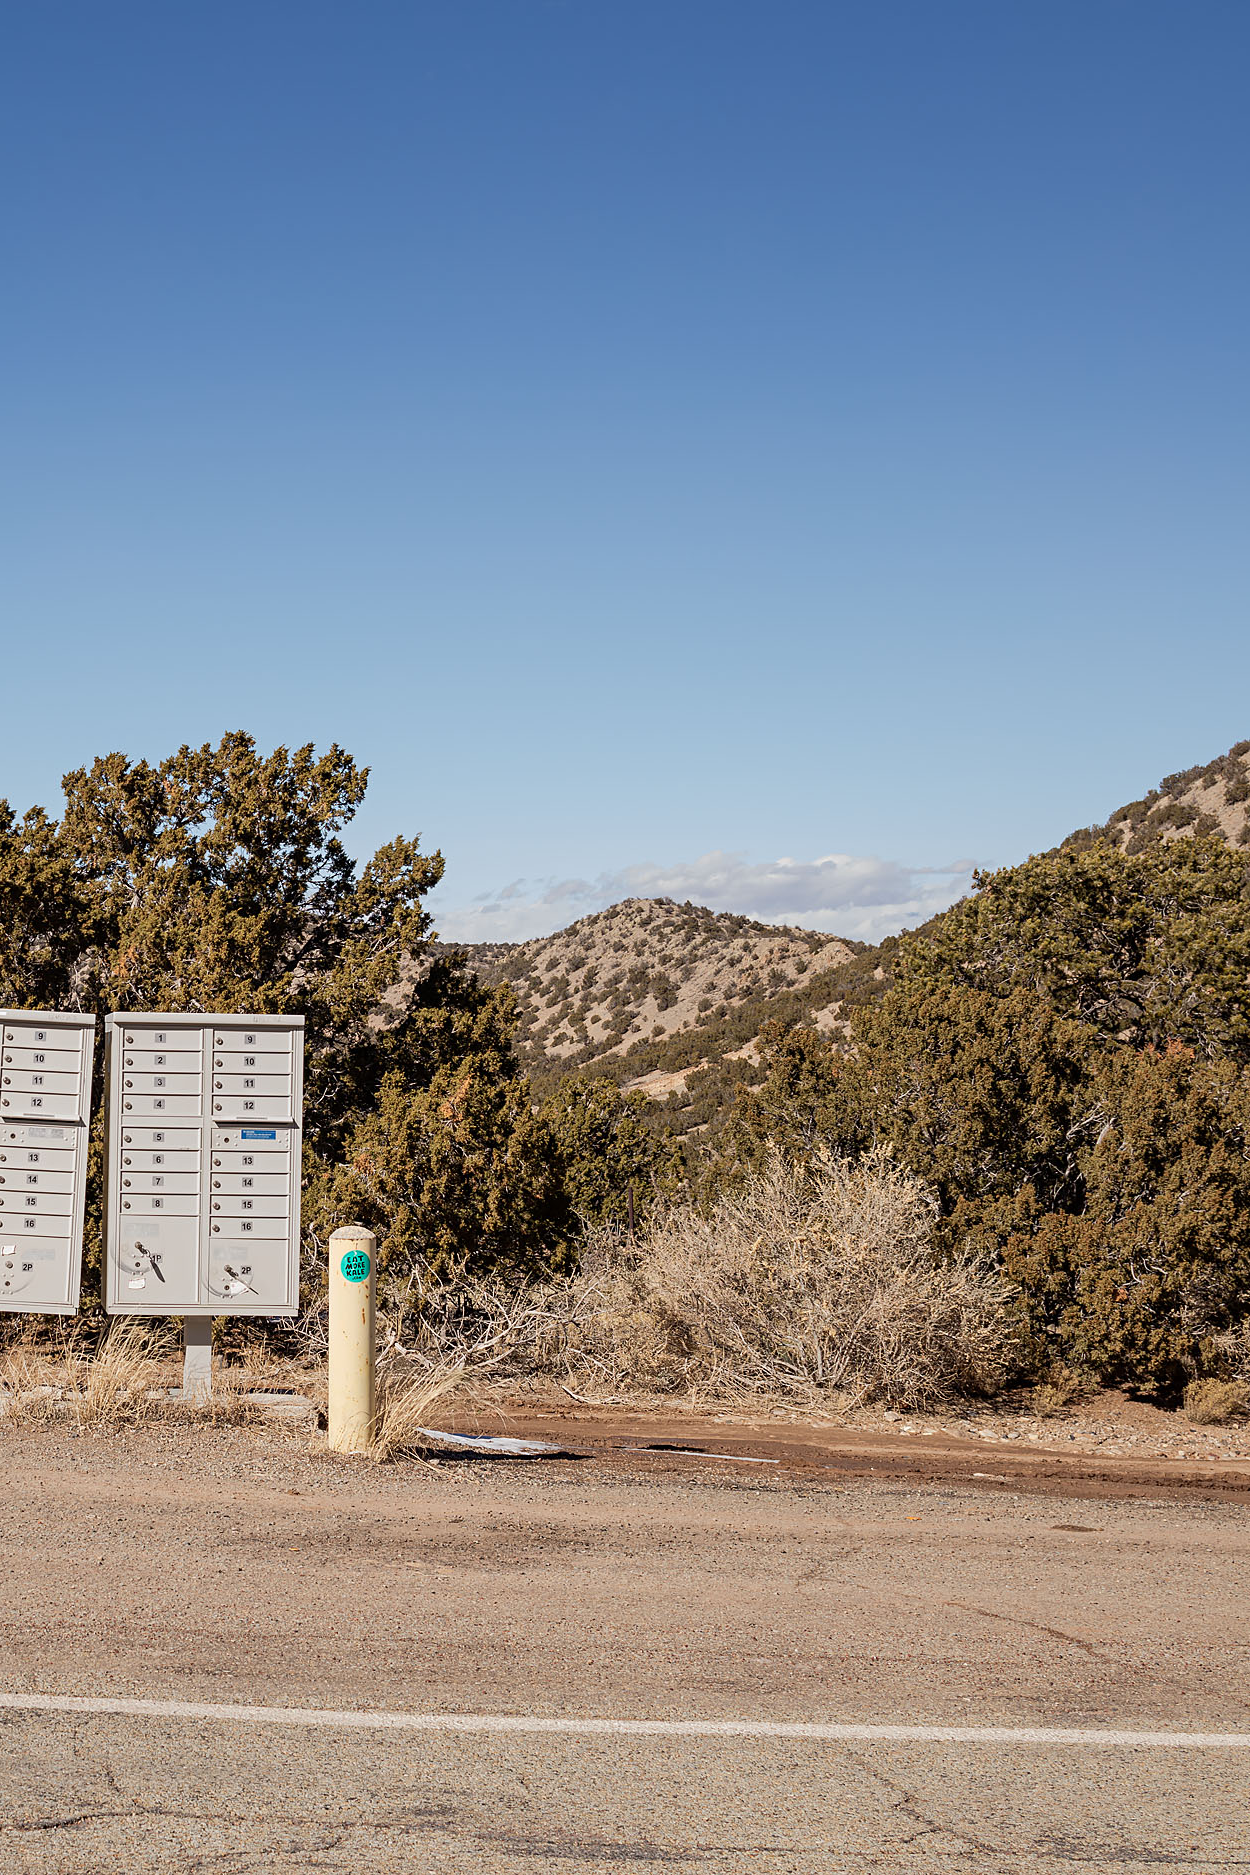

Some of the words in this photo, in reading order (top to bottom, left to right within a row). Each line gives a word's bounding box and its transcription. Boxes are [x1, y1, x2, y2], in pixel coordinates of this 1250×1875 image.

[248, 1035, 253, 1043] 9
[34, 1054, 44, 1062] 10
[158, 1056, 163, 1064] 2
[245, 1057, 254, 1065] 10
[34, 1076, 42, 1084] 11
[245, 1079, 253, 1087] 11
[32, 1098, 41, 1106] 12
[244, 1101, 253, 1109] 12
[157, 1133, 162, 1141] 5
[29, 1153, 38, 1161] 13
[156, 1155, 162, 1163] 6
[243, 1156, 252, 1164] 13
[27, 1175, 36, 1183] 14
[156, 1178, 161, 1186] 7
[242, 1178, 252, 1186] 14
[26, 1197, 35, 1205] 15
[154, 1199, 160, 1207] 8
[242, 1200, 252, 1208] 15
[25, 1219, 34, 1227] 16
[241, 1222, 251, 1230] 16
[22, 1263, 32, 1271] 2P
[241, 1266, 251, 1274] 2P
[345, 1262, 365, 1270] MORE
[346, 1268, 365, 1276] KALE
